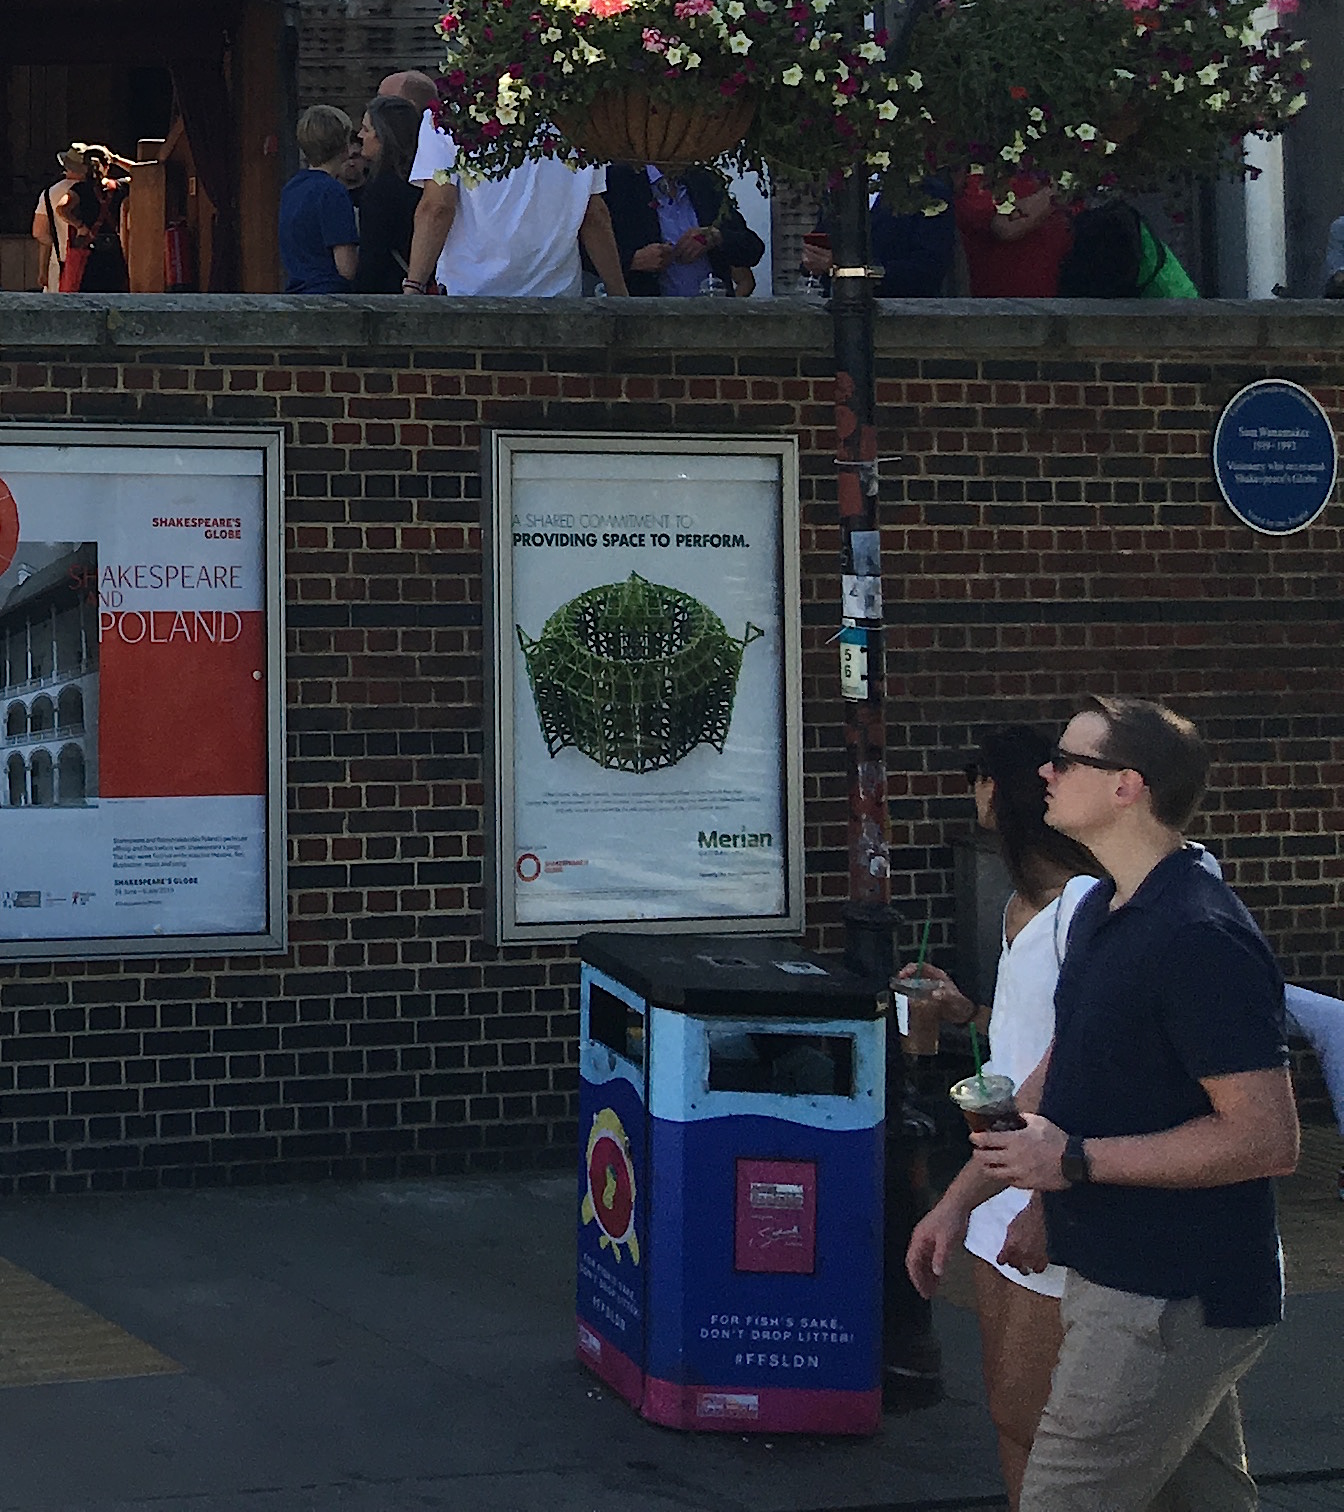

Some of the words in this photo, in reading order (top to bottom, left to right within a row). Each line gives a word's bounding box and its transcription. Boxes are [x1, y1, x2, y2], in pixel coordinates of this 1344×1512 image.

[152, 517, 242, 528] SHAKESPEARE'S
[511, 514, 522, 529] A
[525, 514, 575, 529] SHARED
[579, 514, 670, 529] COMMITMENT
[676, 514, 696, 529] TO
[204, 529, 242, 540] GLOBE
[513, 532, 598, 548] PROVIDING
[602, 533, 646, 548] SPACE
[649, 533, 671, 548] TO
[676, 534, 751, 548] PERFORM.
[68, 563, 243, 590] SHAKESPEARE
[85, 589, 124, 608] AND
[98, 610, 243, 644] POLAND
[844, 648, 852, 662] 5
[844, 664, 852, 679] 6
[697, 825, 774, 849] Merian
[710, 1314, 740, 1326] FOR
[745, 1316, 794, 1328] FISH'S
[699, 1328, 745, 1339] DON'T
[751, 1329, 793, 1341] DROP
[735, 1352, 819, 1369] #FFSLDN
